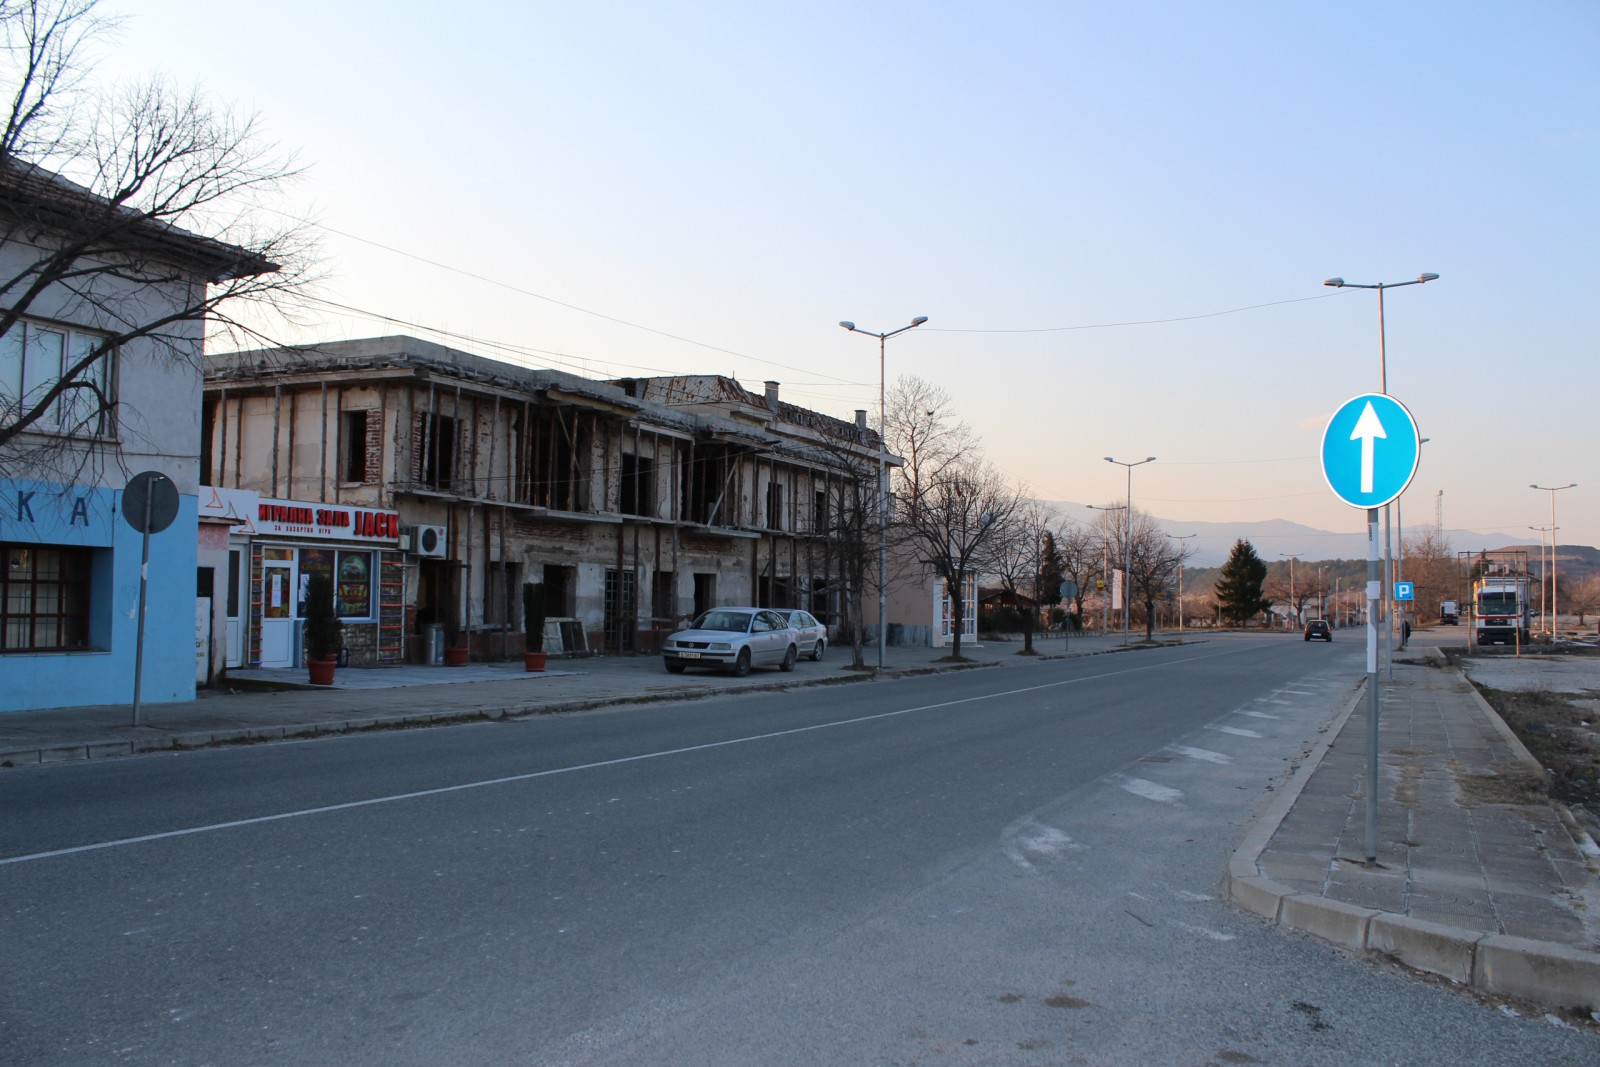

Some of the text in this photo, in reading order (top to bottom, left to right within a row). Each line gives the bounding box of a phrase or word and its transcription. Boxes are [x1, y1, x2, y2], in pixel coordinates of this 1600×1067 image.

[258, 504, 350, 527] ИГРАЛНА ЗАЛА
[354, 511, 399, 538] JACK
[1399, 585, 1409, 597] P
